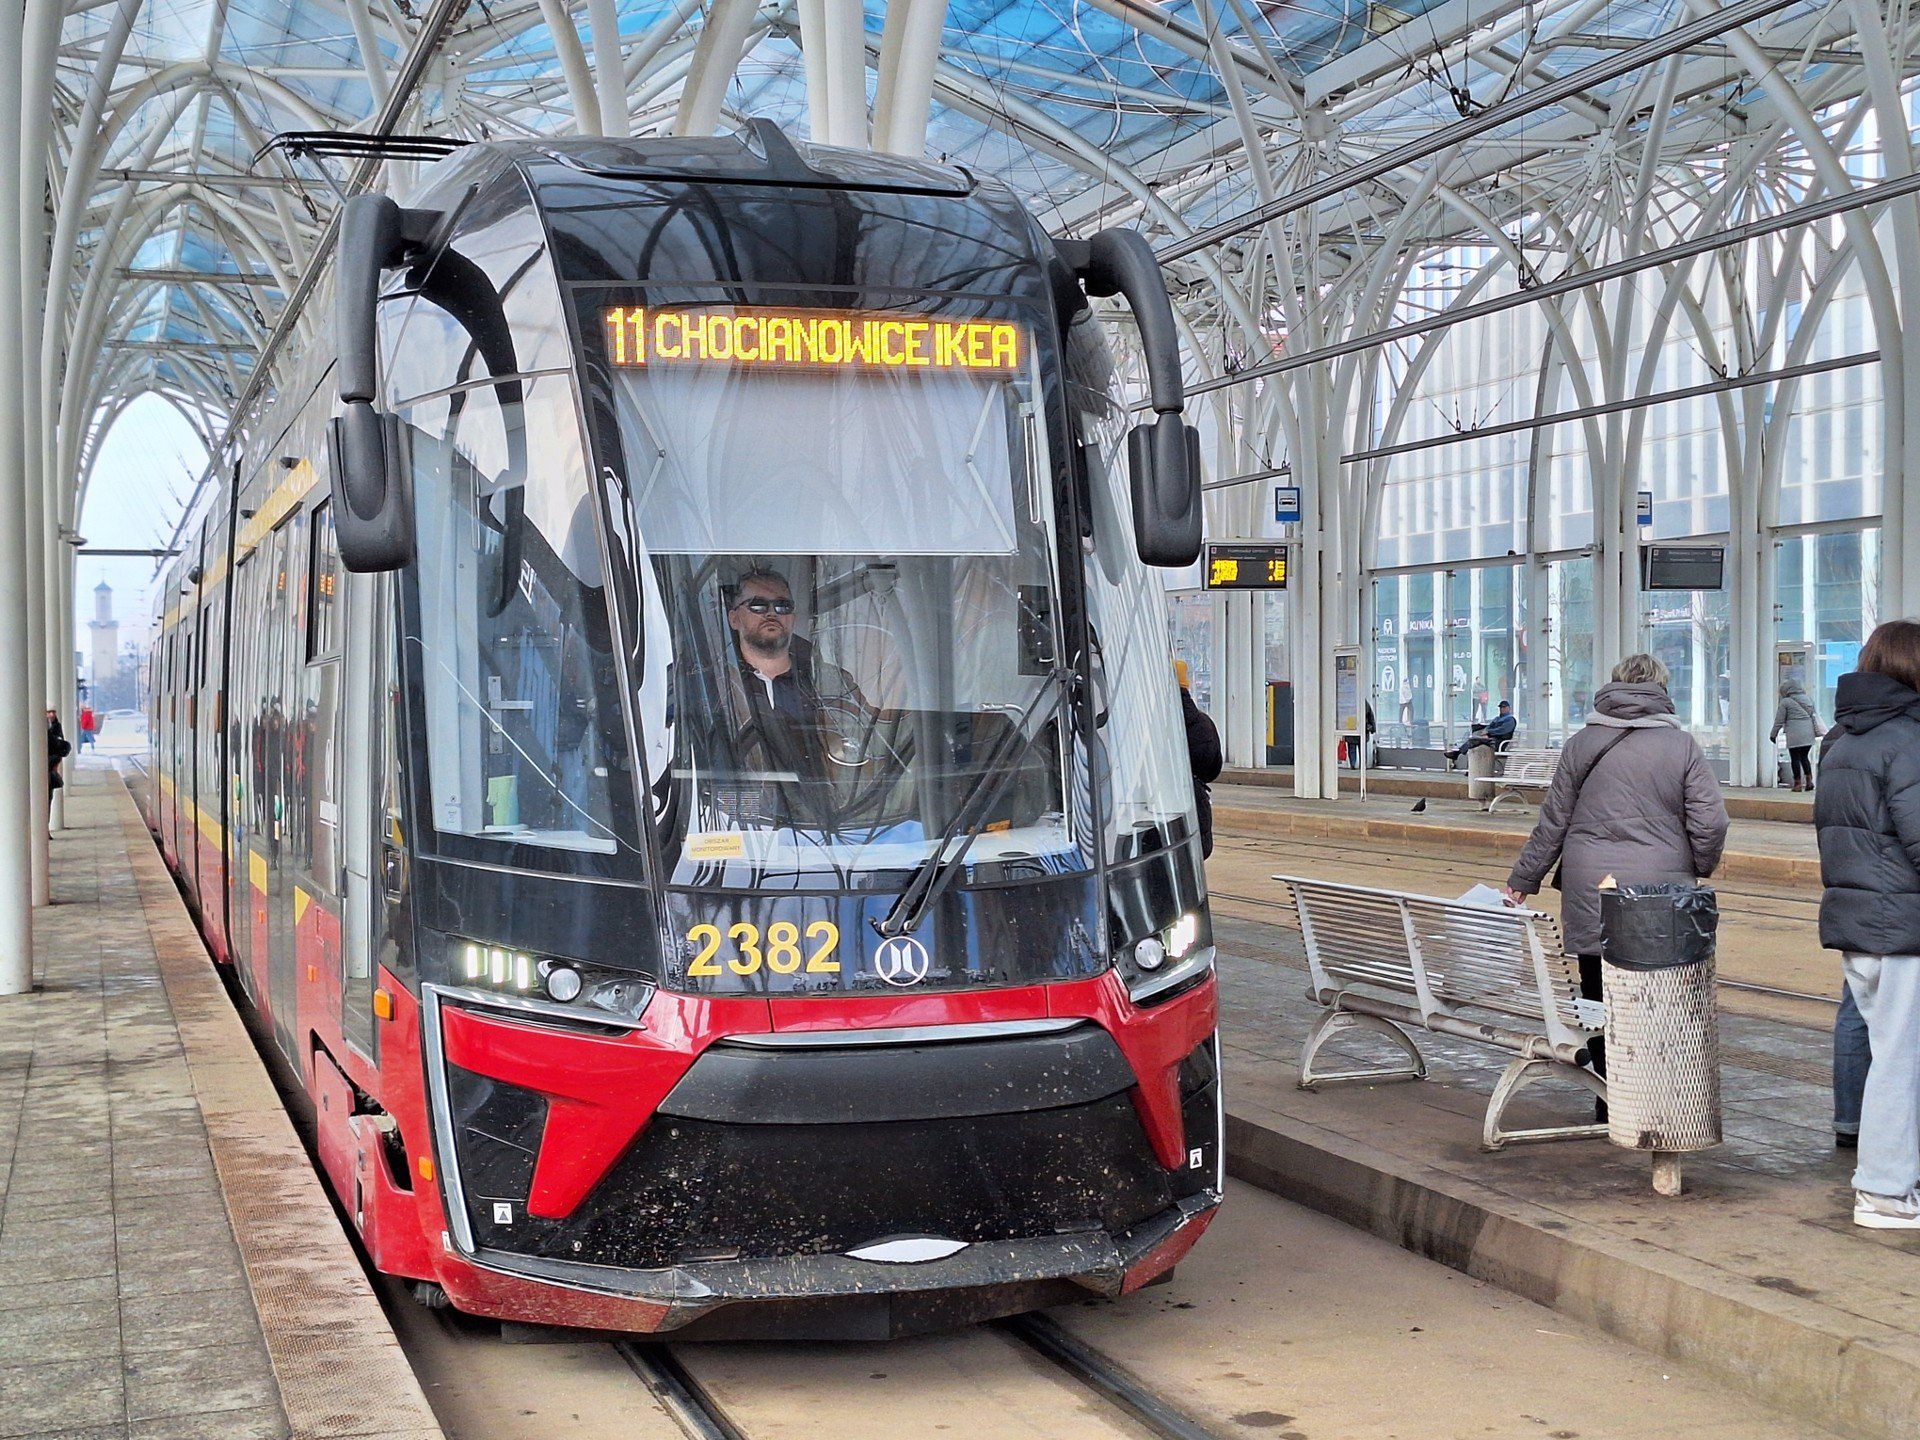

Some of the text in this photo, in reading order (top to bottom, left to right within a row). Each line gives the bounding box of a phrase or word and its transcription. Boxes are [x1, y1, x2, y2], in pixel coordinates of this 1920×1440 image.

[607, 307, 1017, 367] 11 CHOCIANOWICE IKEA
[687, 921, 841, 976] 2382
